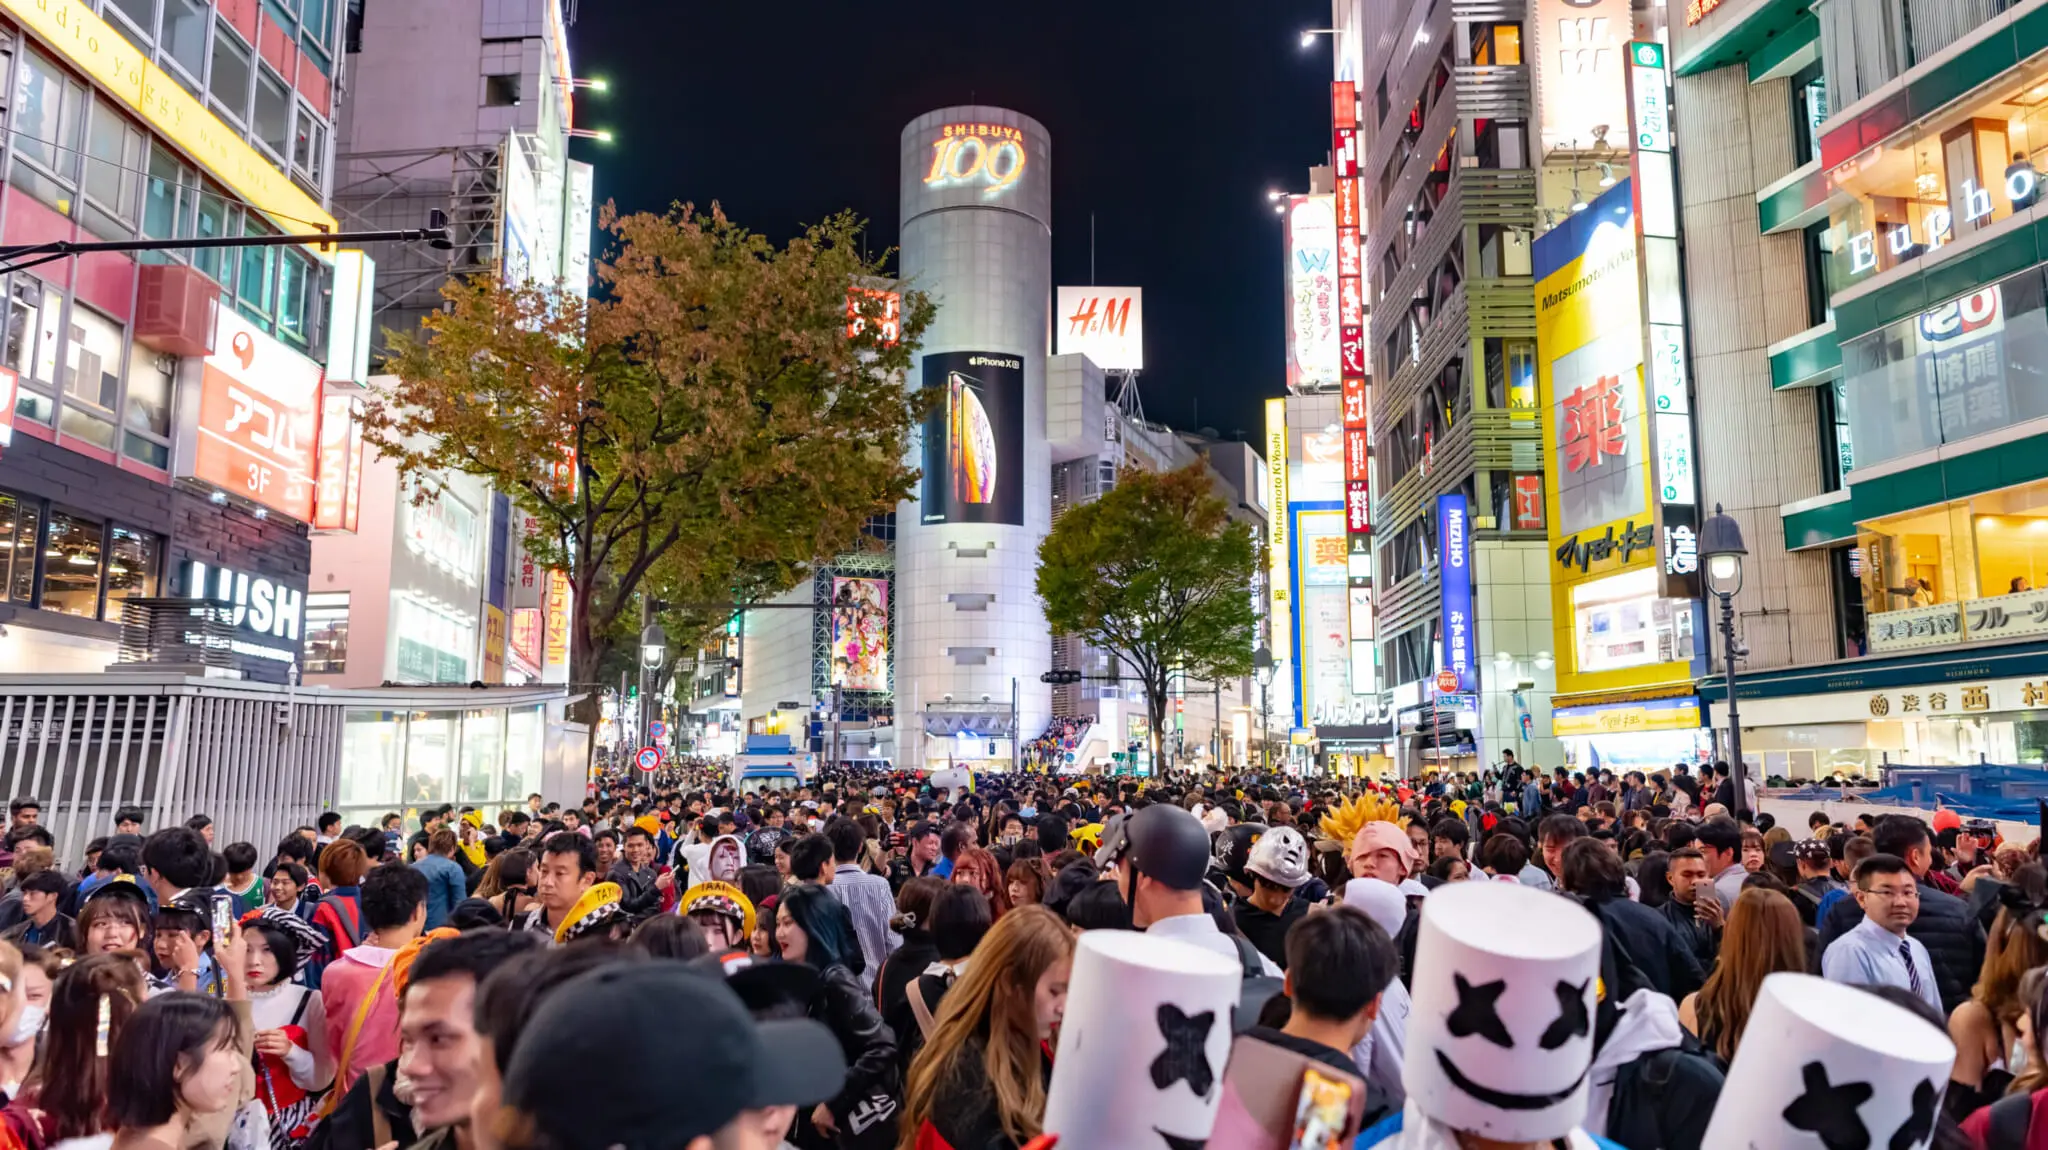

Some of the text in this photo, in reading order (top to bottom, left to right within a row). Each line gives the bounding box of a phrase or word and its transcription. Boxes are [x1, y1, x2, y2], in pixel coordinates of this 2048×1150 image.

[113, 56, 184, 126] yoggy
[943, 124, 1023, 142] SHIBUYA
[922, 135, 1026, 193] 109
[1847, 169, 2036, 276] Eupho
[1068, 296, 1132, 337] H&M
[1541, 267, 1607, 312] Matsumoto
[976, 356, 1006, 368] iPhone
[225, 385, 304, 461] アコム
[1562, 375, 1629, 473] 薬
[247, 463, 272, 494] 3F
[1272, 433, 1282, 475] KiYoshi
[1273, 477, 1284, 545] Matsumoto
[1449, 508, 1464, 568] MIZUHO
[1315, 537, 1347, 565] 薬
[1556, 521, 1656, 573] マツモトキヨ
[190, 560, 302, 640] LUSH
[1877, 612, 1961, 642] 渋谷西村
[1450, 610, 1467, 676] みずほ銀行
